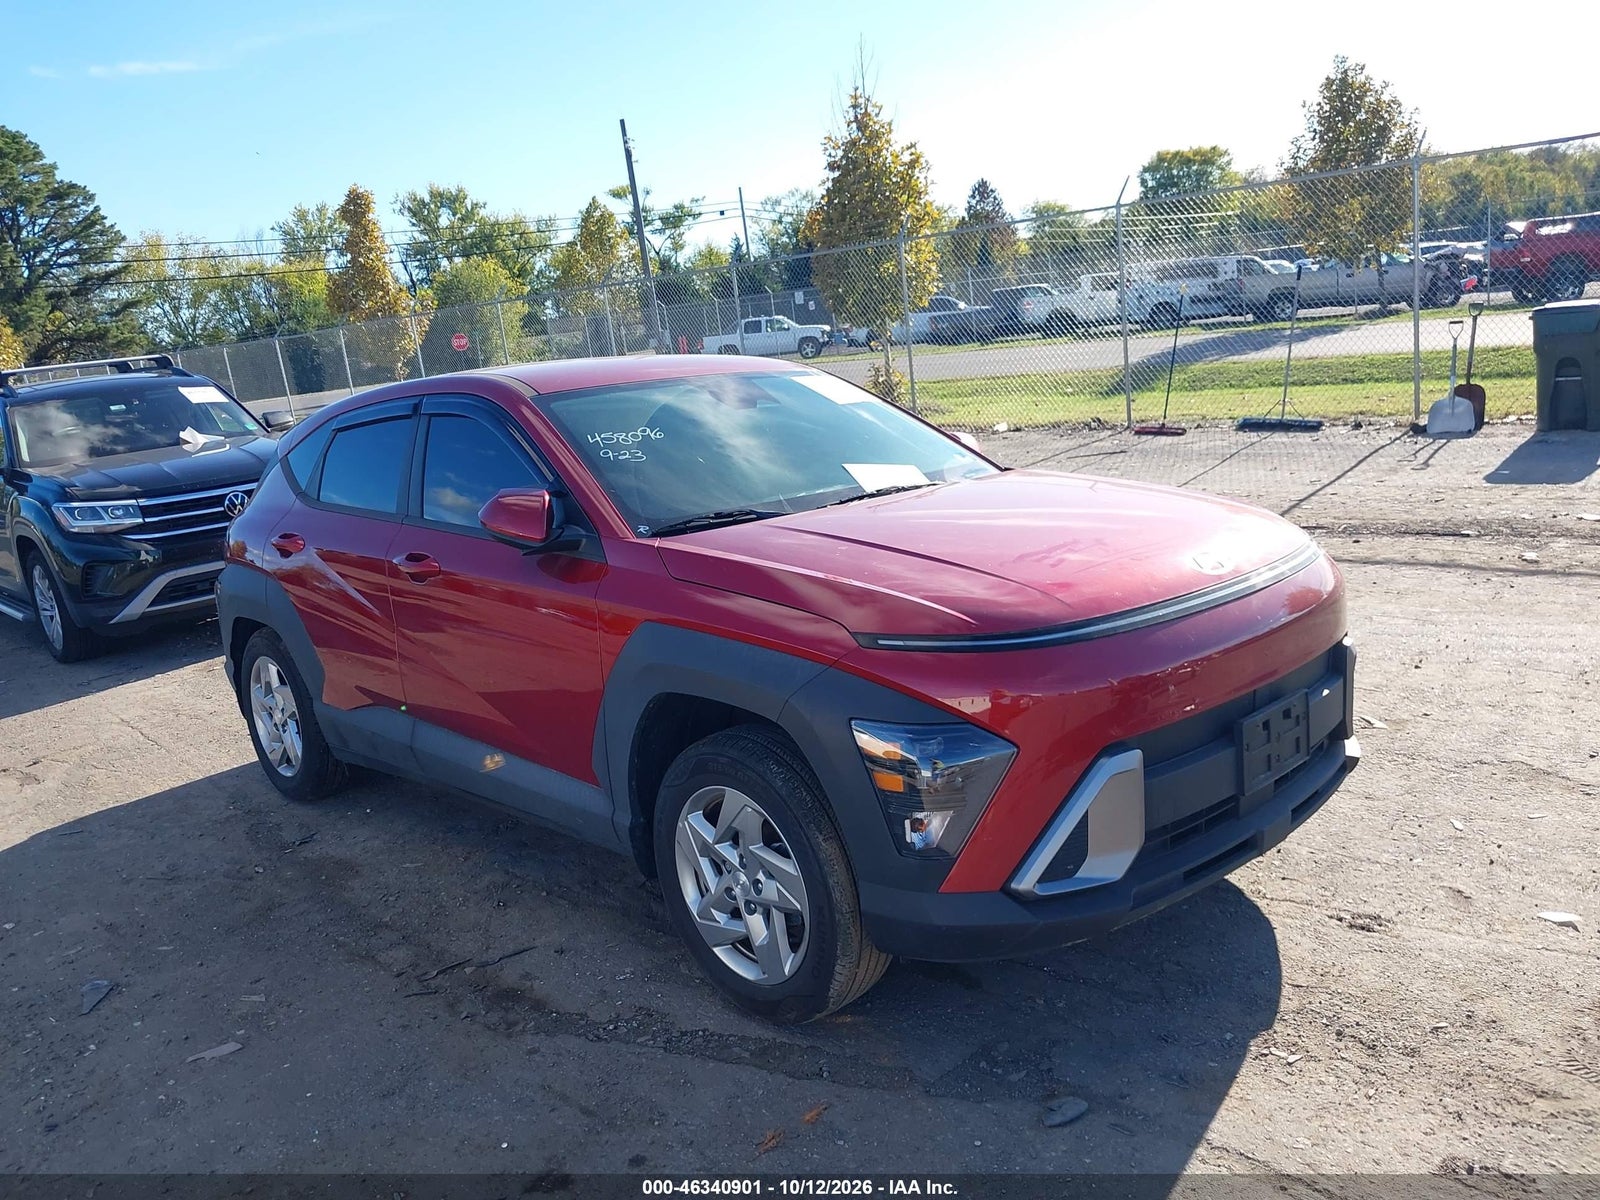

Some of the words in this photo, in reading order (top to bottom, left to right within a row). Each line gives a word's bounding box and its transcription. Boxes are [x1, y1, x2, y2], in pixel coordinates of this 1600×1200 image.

[453, 339, 468, 347] STOP
[587, 427, 664, 447] 458096
[600, 449, 646, 461] 9-23
